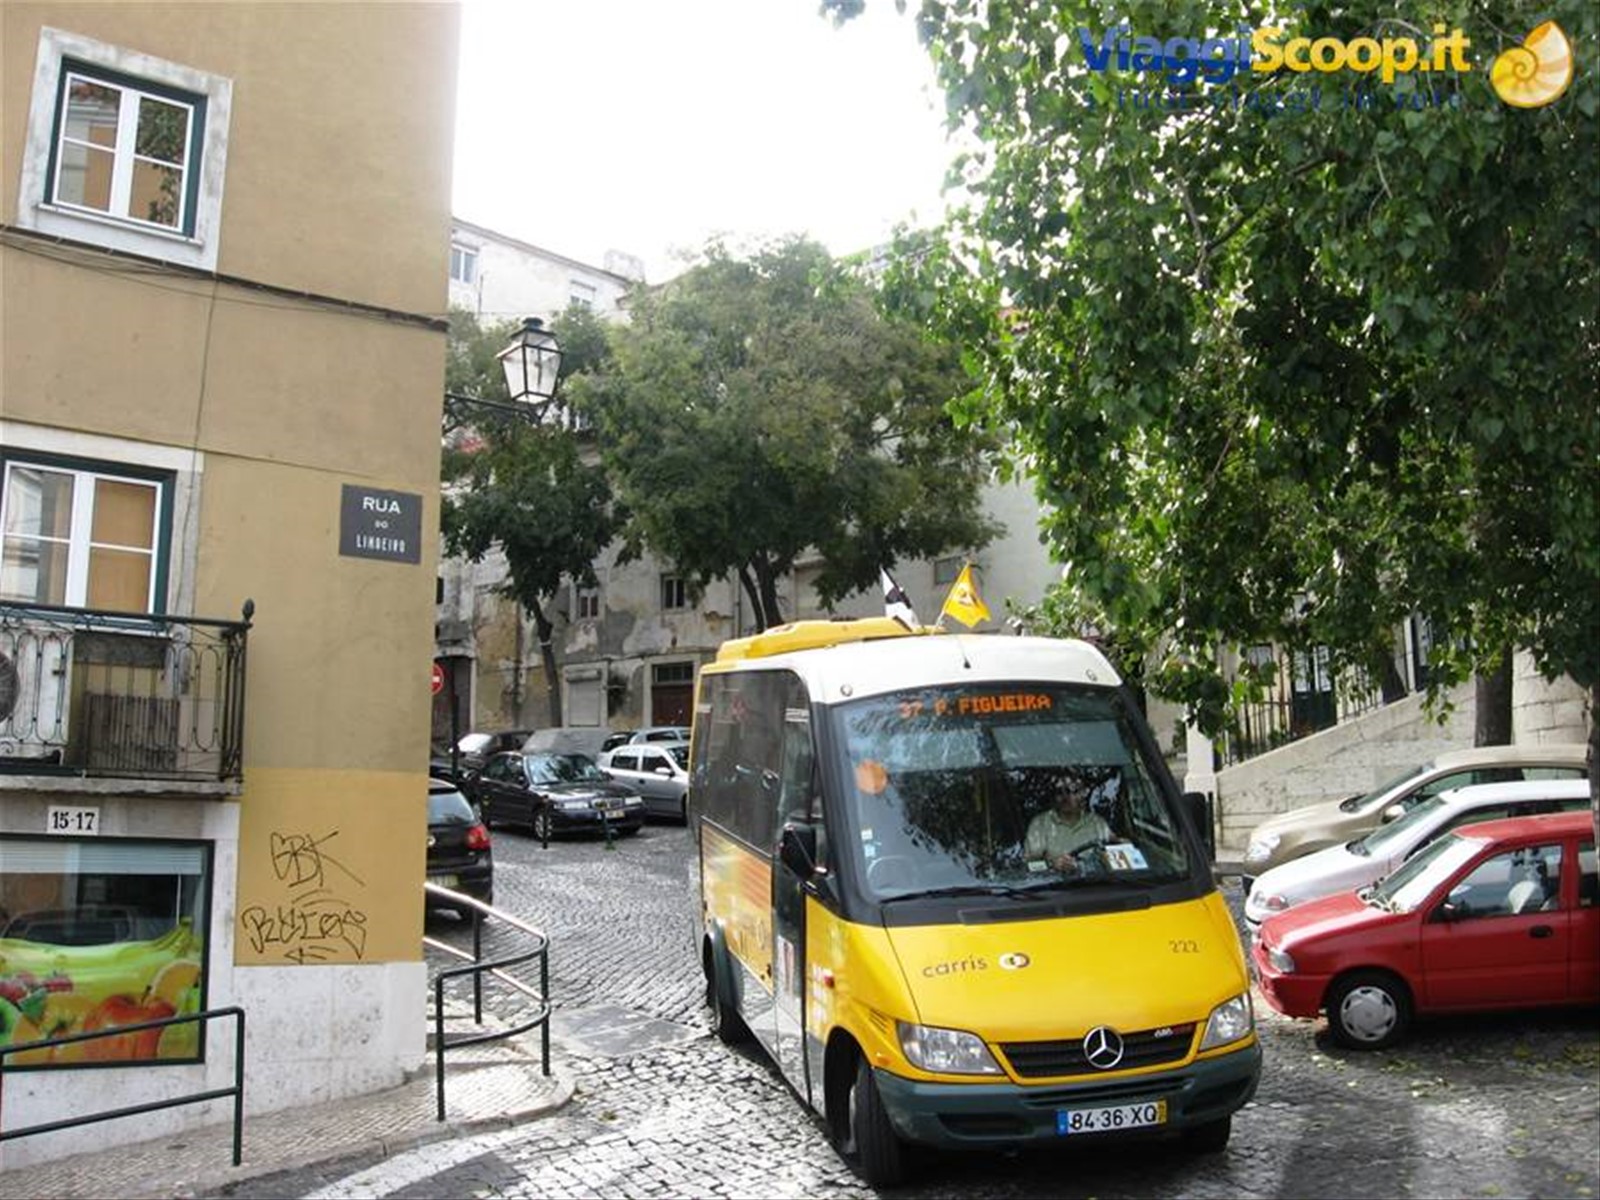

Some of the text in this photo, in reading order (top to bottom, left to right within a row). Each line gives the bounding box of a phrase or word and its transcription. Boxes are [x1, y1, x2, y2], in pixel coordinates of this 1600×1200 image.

[362, 496, 401, 514] RUA
[1168, 939, 1201, 954] 222
[922, 954, 988, 978] carris
